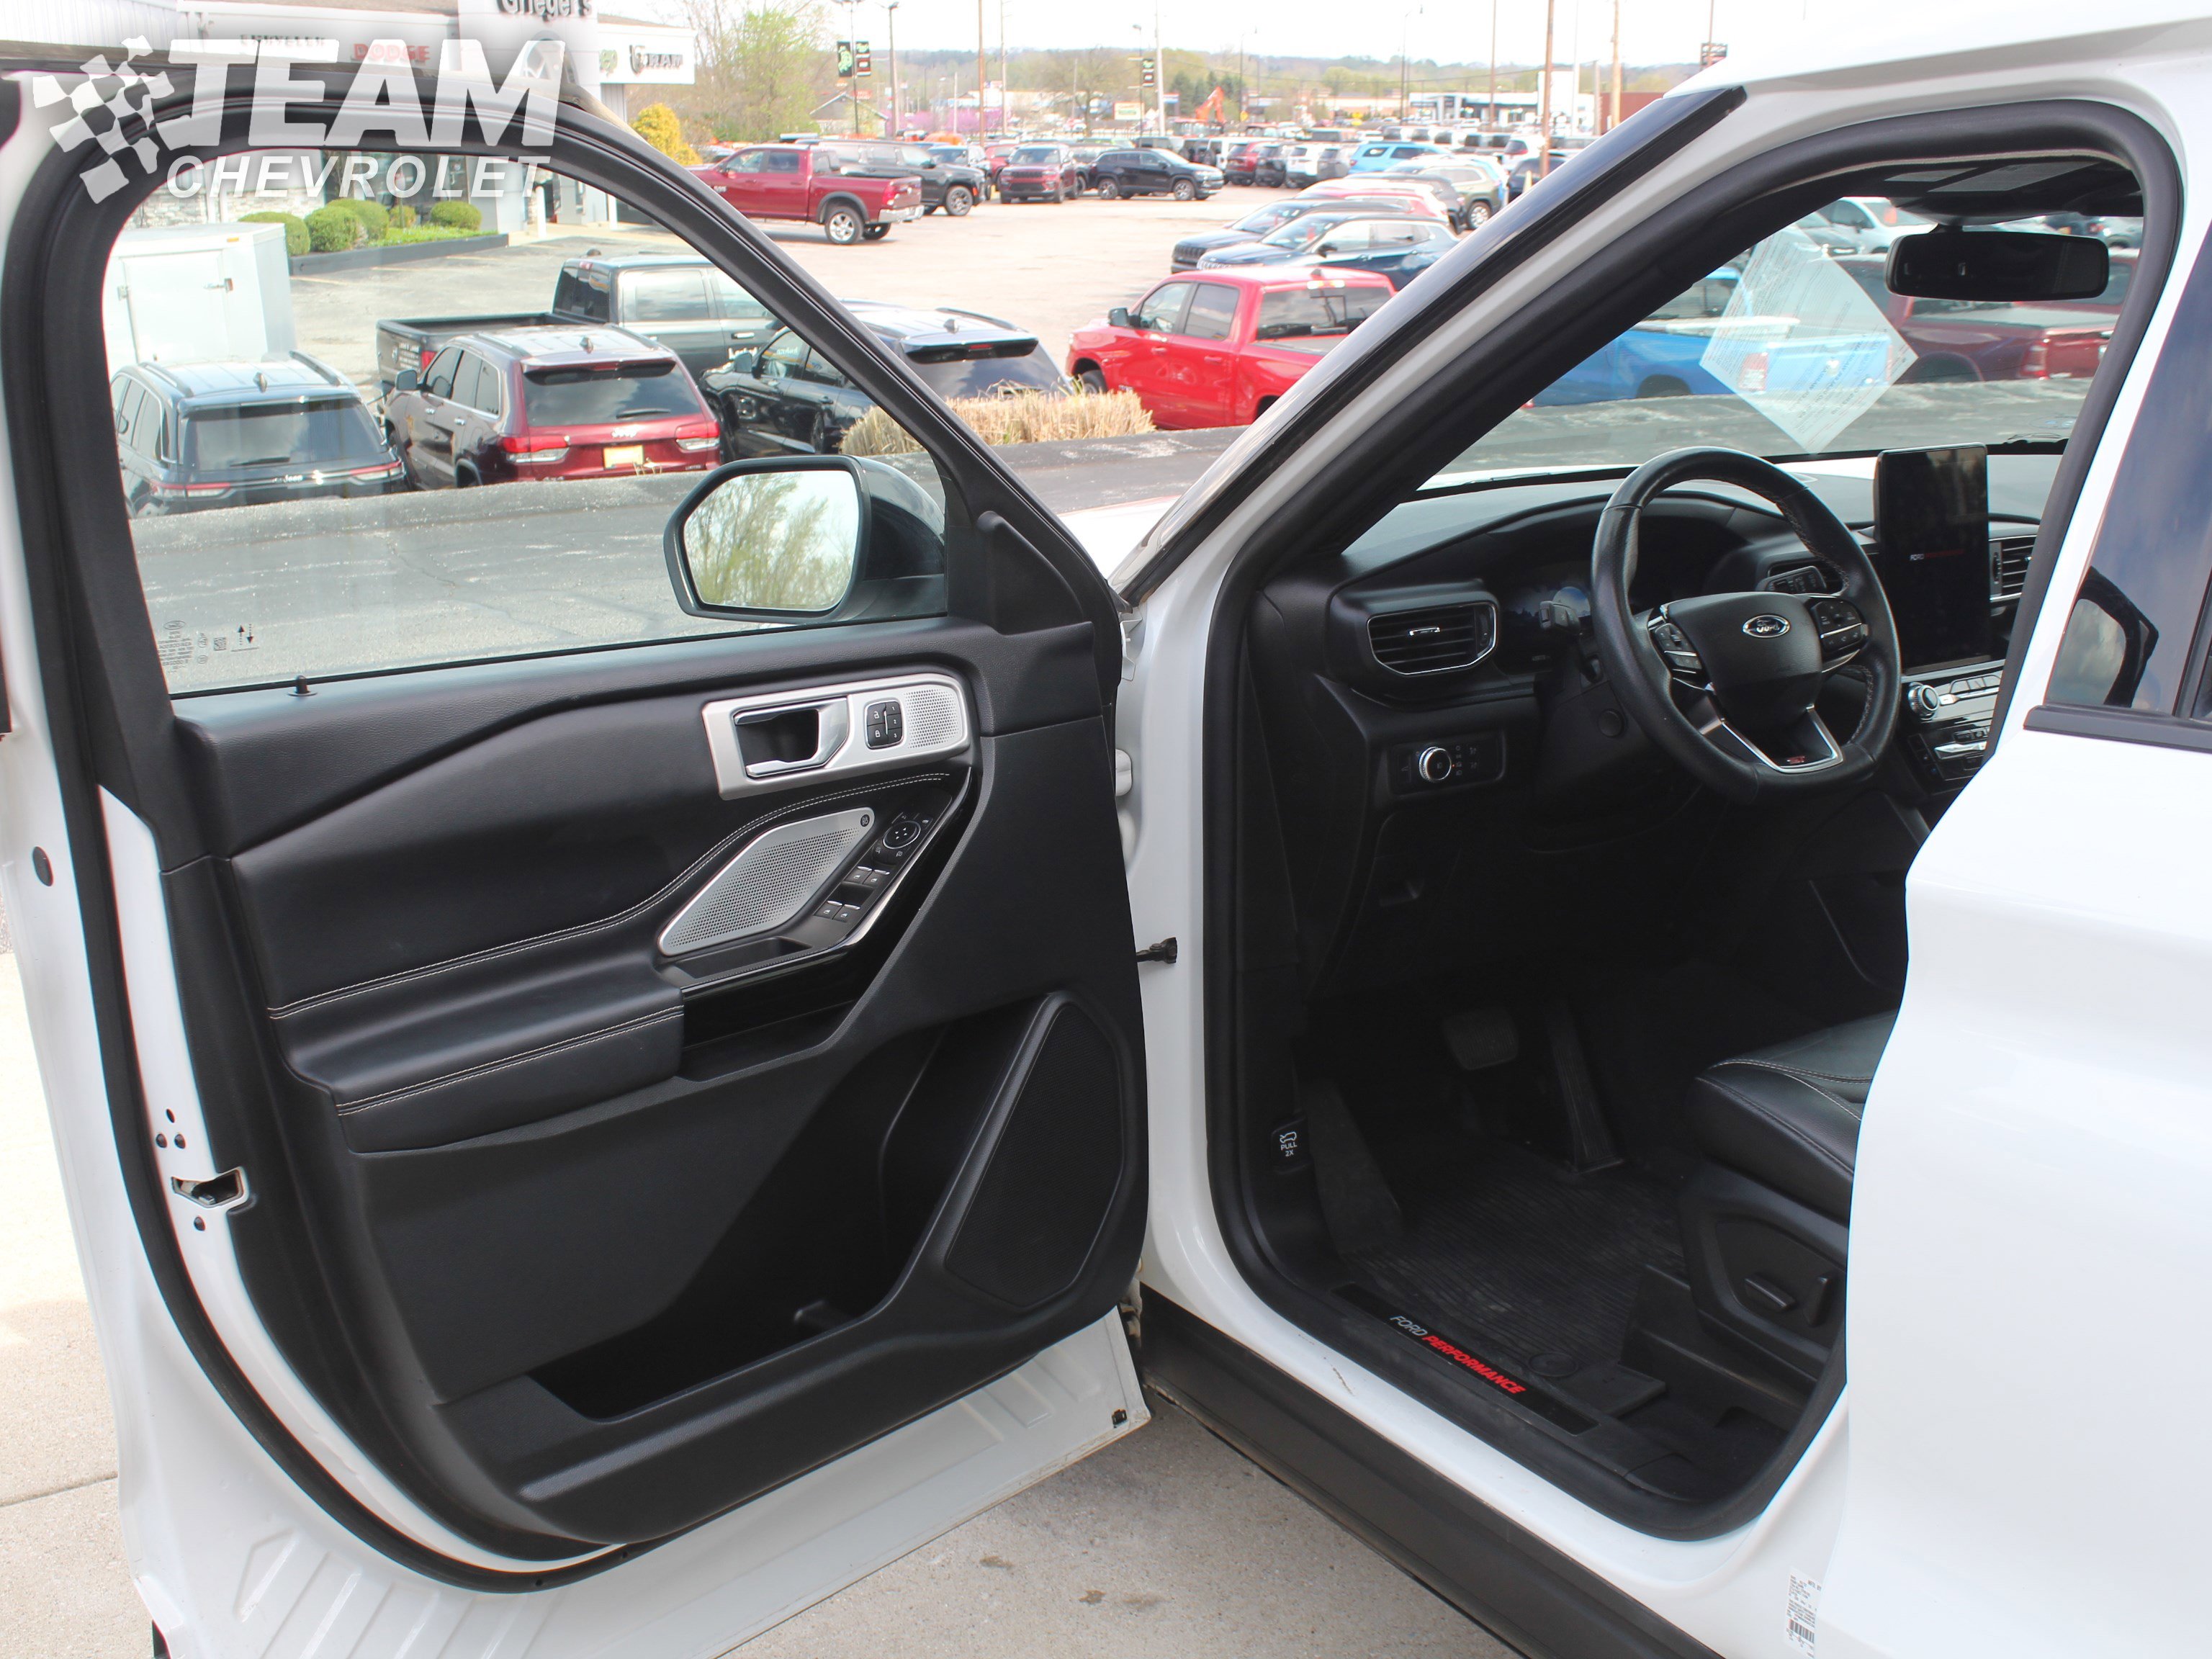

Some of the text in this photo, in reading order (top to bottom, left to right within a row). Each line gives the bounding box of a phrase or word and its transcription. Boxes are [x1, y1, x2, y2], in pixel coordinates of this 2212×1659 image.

[352, 42, 431, 62] DODGE
[1280, 1141, 1298, 1151] PULL
[1390, 1315, 1527, 1394] FORD PERFORMANCE
